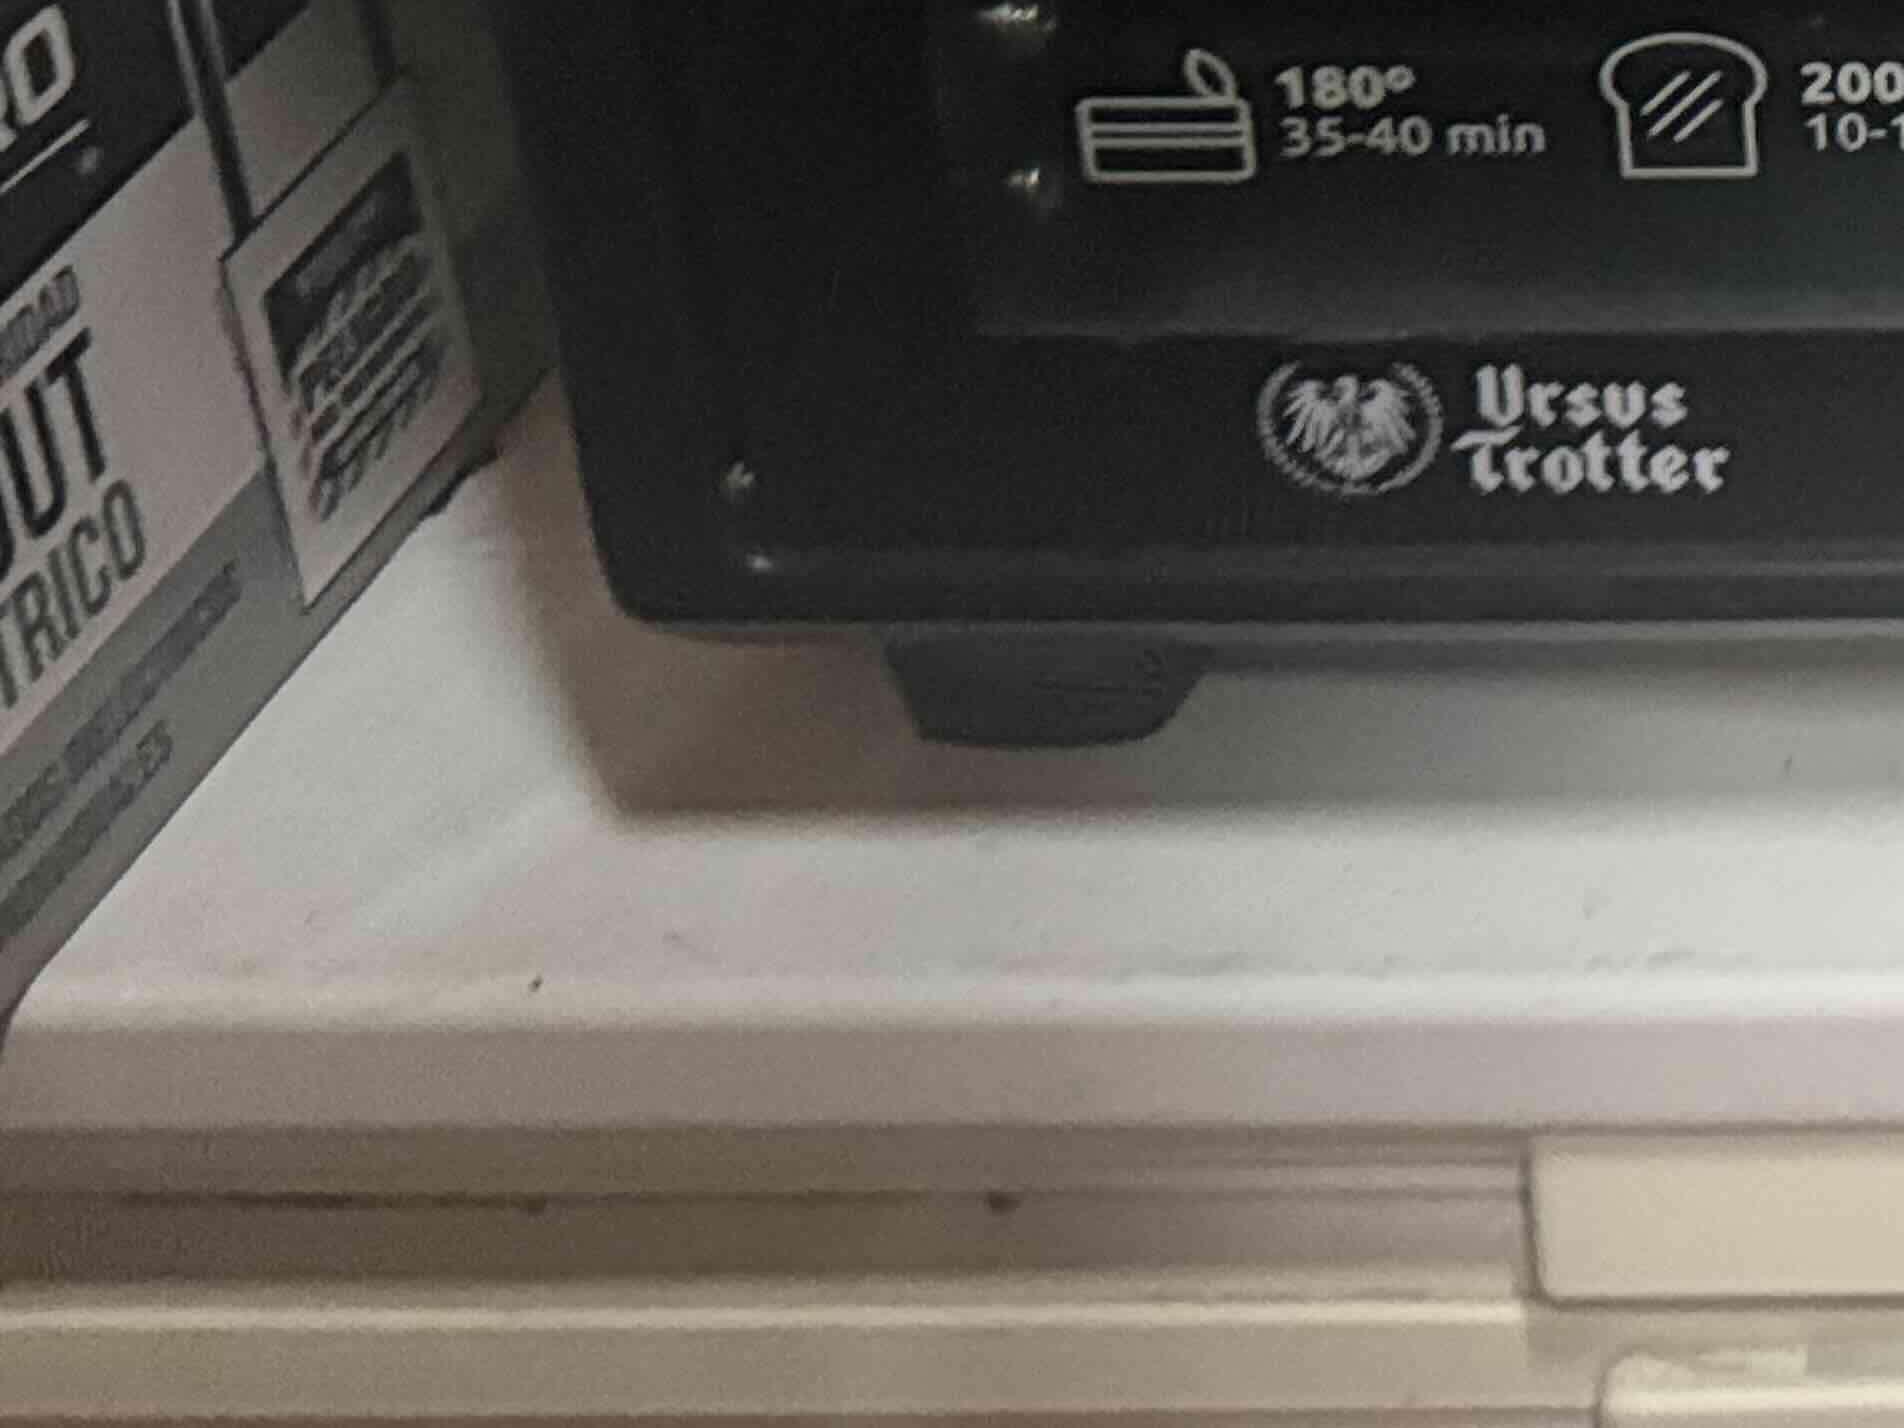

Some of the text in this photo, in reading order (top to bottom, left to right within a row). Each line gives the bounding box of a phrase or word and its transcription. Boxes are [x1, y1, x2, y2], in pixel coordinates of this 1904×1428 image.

[1280, 113, 1547, 158] 35-40 min
[1476, 363, 1688, 427] Ursus
[1449, 424, 1730, 494] Trotter
